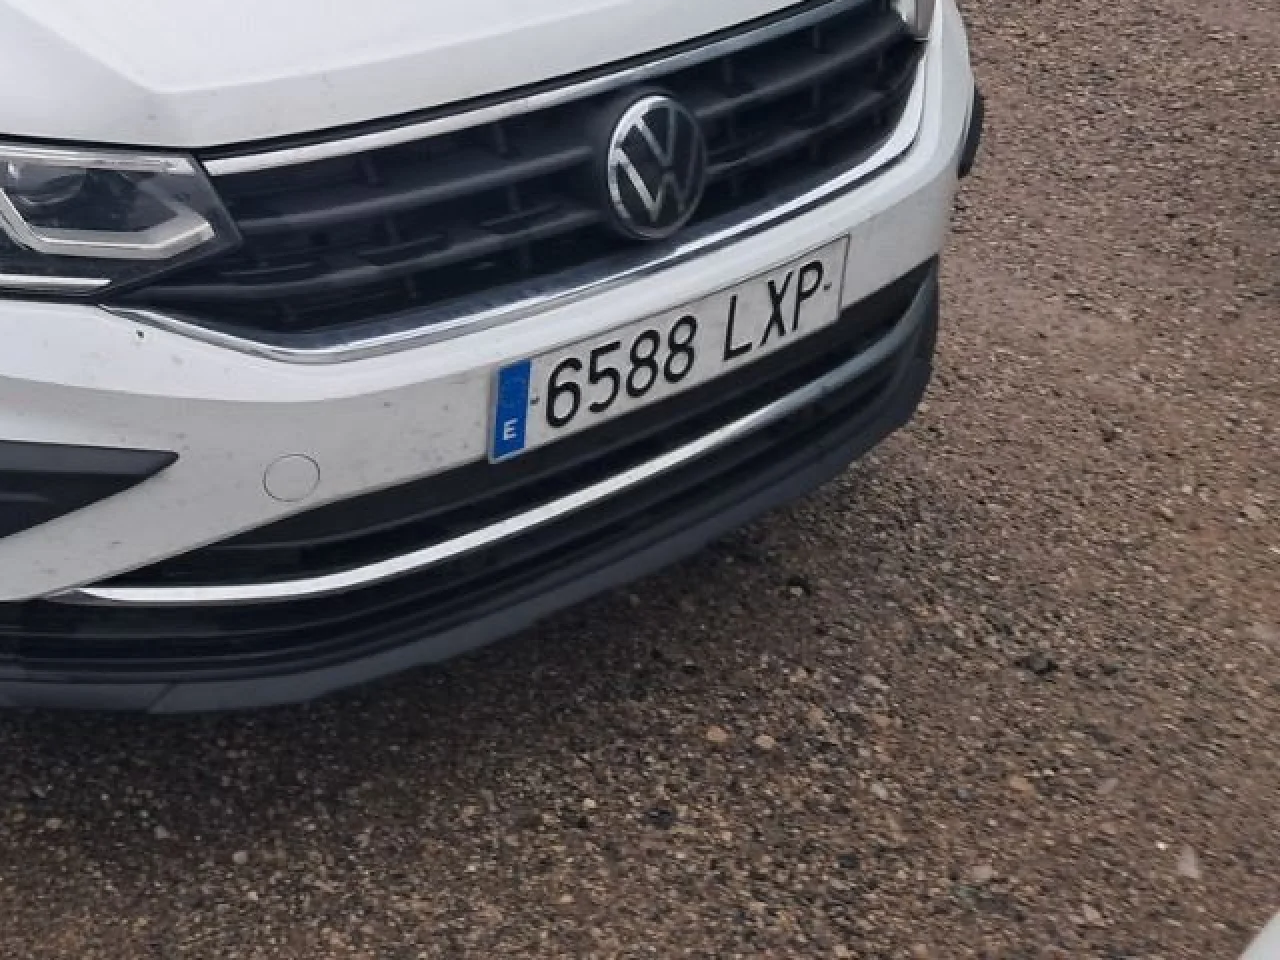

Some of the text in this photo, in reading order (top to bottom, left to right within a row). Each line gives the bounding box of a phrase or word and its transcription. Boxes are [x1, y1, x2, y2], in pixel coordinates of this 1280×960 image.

[502, 260, 824, 441] E 6588 LXP
